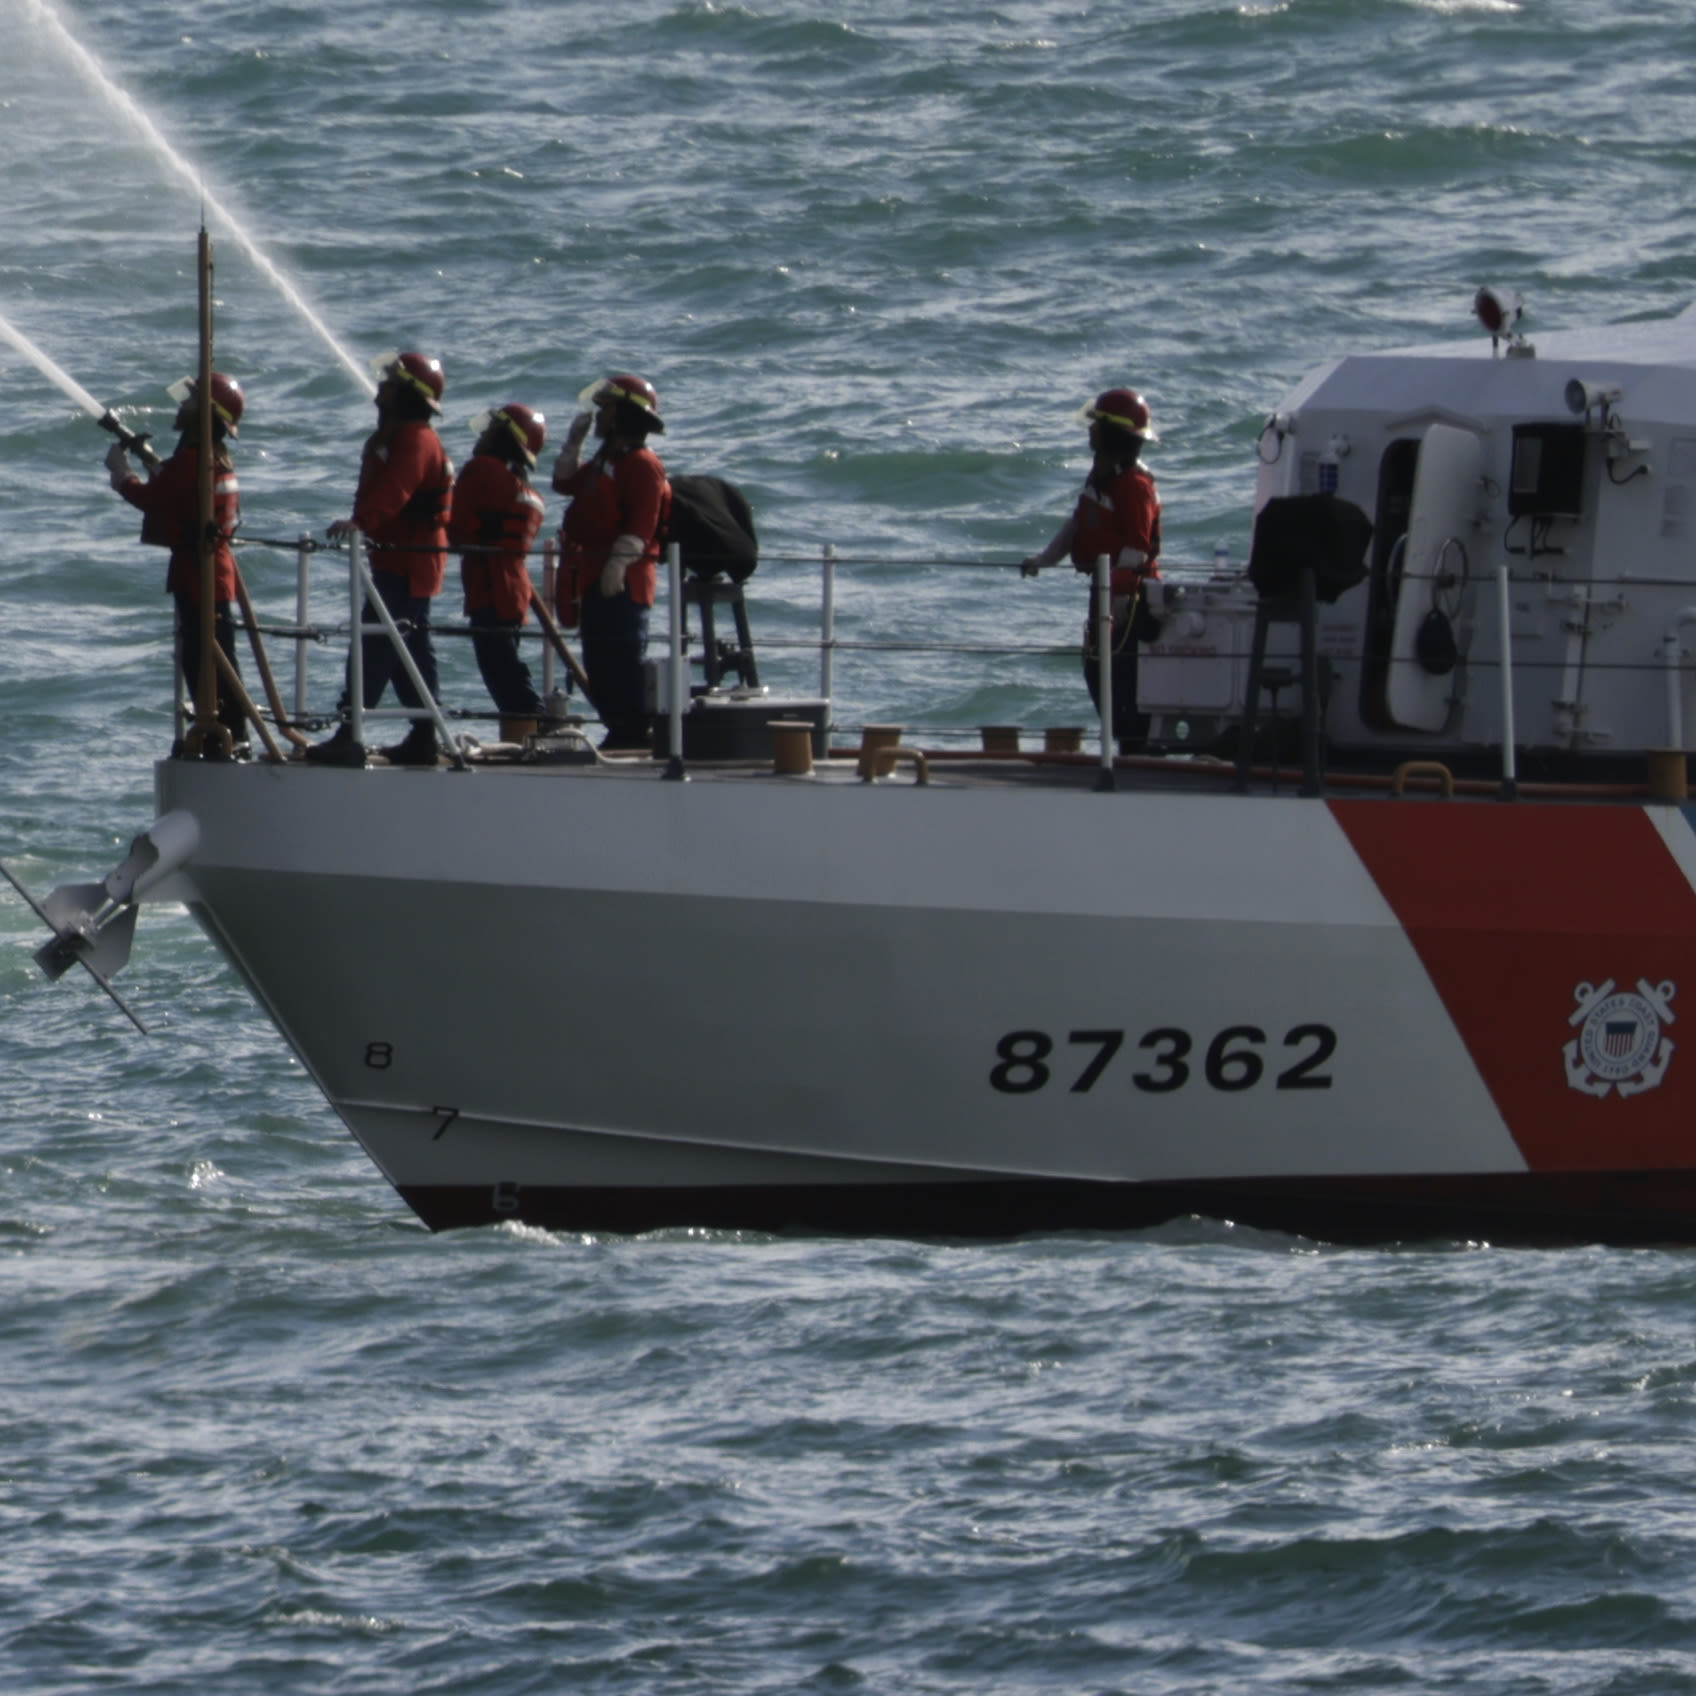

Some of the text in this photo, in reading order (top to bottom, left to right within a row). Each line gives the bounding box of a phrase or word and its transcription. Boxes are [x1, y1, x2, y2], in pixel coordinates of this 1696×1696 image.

[365, 1042, 393, 1069] 8
[988, 1023, 1338, 1094] 87362
[431, 1106, 460, 1140] 7
[493, 1182, 519, 1212] 6
